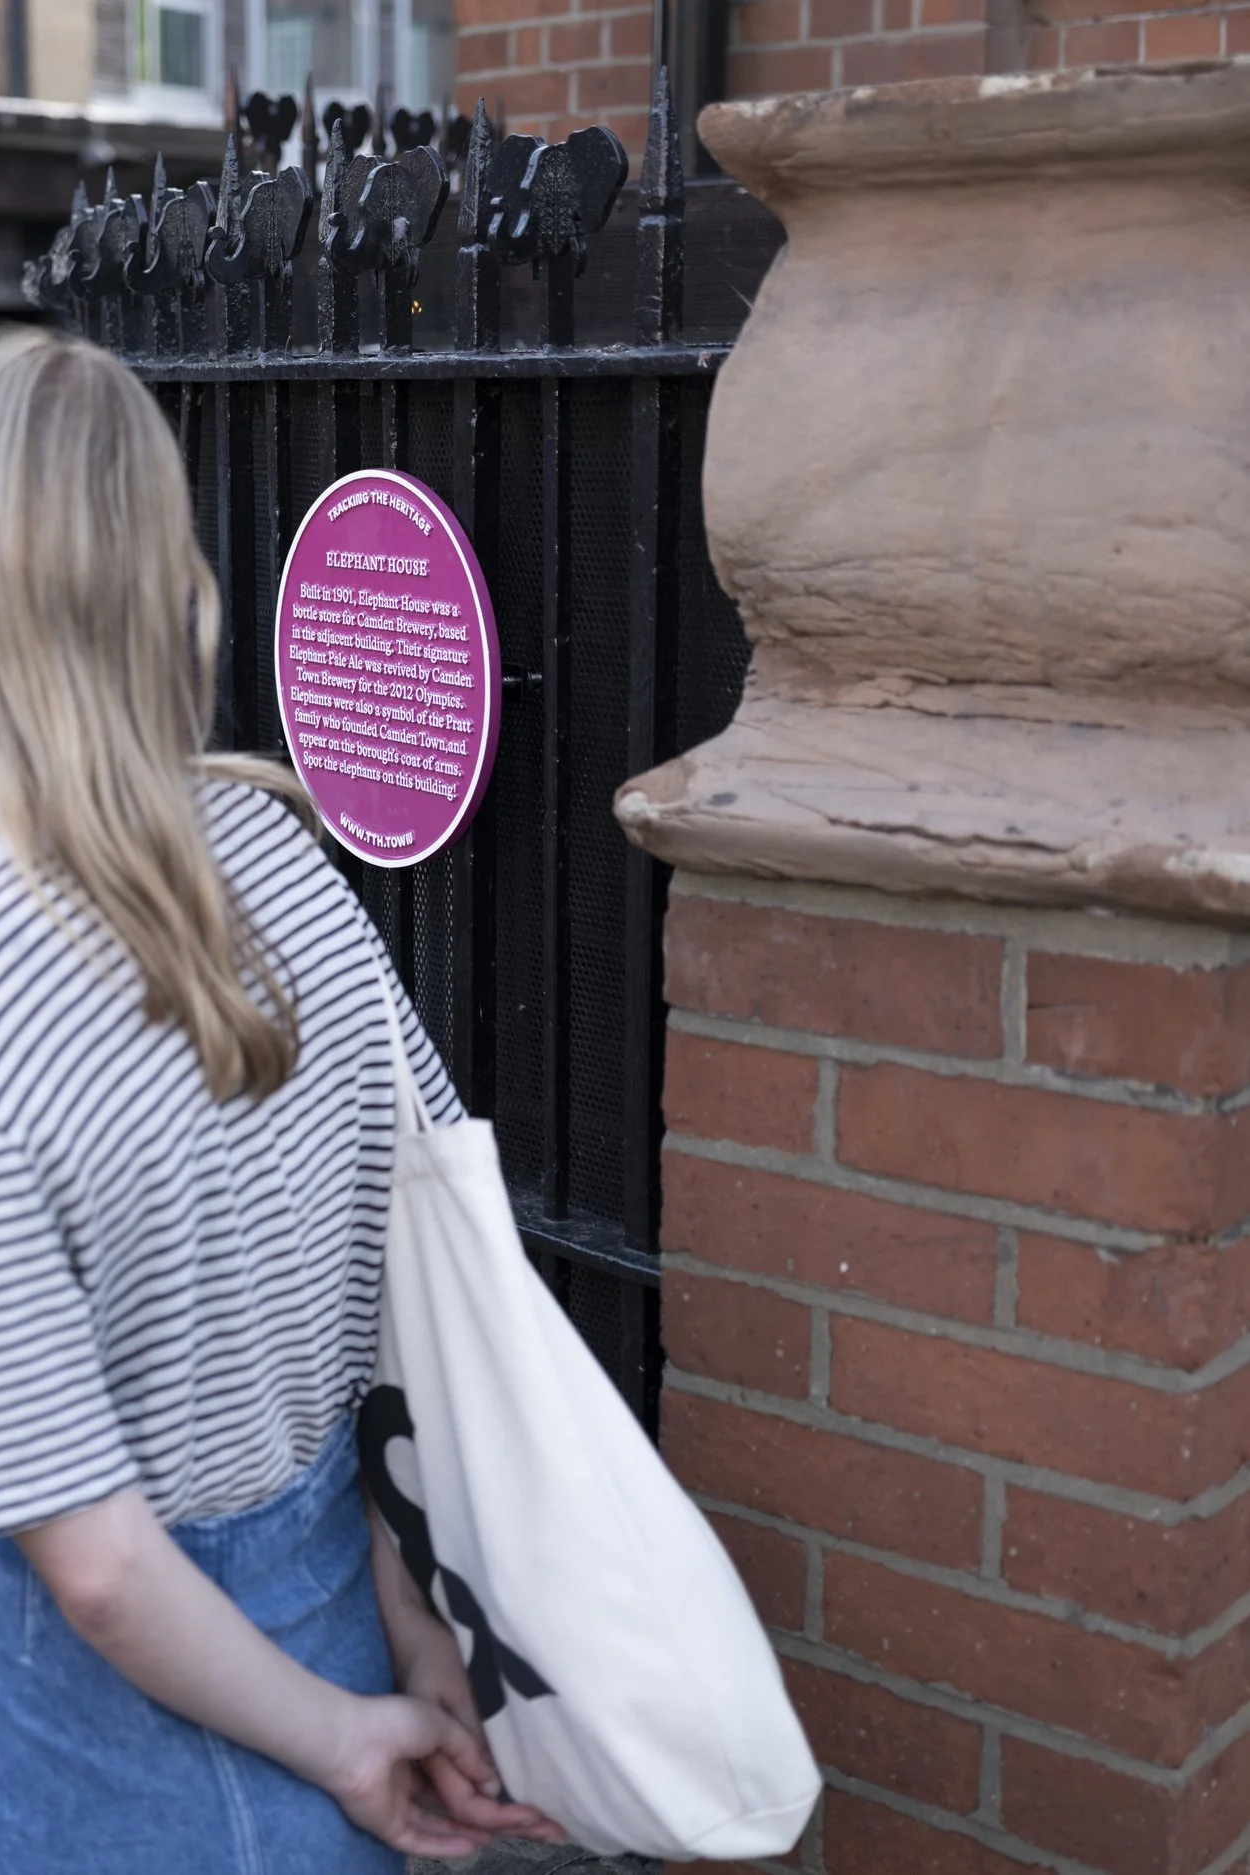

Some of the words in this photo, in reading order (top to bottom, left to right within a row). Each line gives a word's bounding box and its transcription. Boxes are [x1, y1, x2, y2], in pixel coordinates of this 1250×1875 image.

[327, 492, 370, 522] TRACKING
[370, 491, 389, 506] THE
[389, 495, 432, 537] HERITAGE
[326, 551, 385, 572] ELEPHANT
[387, 557, 428, 577] HOUSE
[300, 583, 321, 600] Built
[322, 586, 331, 602] in
[333, 587, 357, 607] 1901,
[358, 590, 399, 611] Elephant
[401, 595, 430, 613] House
[432, 602, 450, 617] was
[452, 604, 459, 618] a
[292, 603, 318, 620] bottle
[319, 609, 341, 624] store
[342, 609, 355, 626] for
[357, 612, 395, 631] Camden
[396, 617, 437, 640] Brewery,
[438, 622, 467, 642] based
[292, 624, 300, 639] in
[302, 626, 316, 641] the
[317, 629, 354, 647] adjacent
[355, 633, 394, 656] building.
[396, 639, 422, 657] Their
[423, 644, 468, 664] signature
[289, 644, 327, 664] Elephant
[328, 651, 347, 669] Pale
[348, 653, 364, 671] Ale
[365, 660, 382, 674] was
[383, 661, 417, 679] revived
[418, 664, 430, 684] by
[432, 667, 473, 688] Camden
[296, 666, 320, 684] Town
[321, 670, 357, 694] Brewery
[358, 677, 372, 693] for
[373, 679, 388, 696] the
[390, 683, 413, 700] 2012
[415, 687, 464, 710] Olympics.
[290, 686, 332, 707] Elephants
[333, 697, 354, 712] were
[355, 699, 374, 715] also
[375, 704, 381, 717] a
[382, 705, 415, 722] symbol
[416, 710, 428, 725] of
[429, 711, 444, 728] the
[445, 714, 472, 733] Pratt
[294, 707, 321, 729] family
[322, 714, 341, 730] who
[342, 717, 379, 738] founded
[379, 724, 418, 745] Camden
[298, 732, 327, 748] appear
[328, 738, 340, 751] on
[341, 739, 355, 754] the
[357, 741, 399, 765] borough's
[401, 753, 421, 768] coat
[422, 755, 434, 771] of
[435, 759, 462, 777] arms.
[303, 751, 323, 768] Spot
[324, 755, 338, 771] the
[339, 759, 381, 781] elephants
[382, 770, 395, 784] on
[396, 770, 413, 788] this
[414, 774, 457, 801] building!
[339, 812, 414, 849] WWW.TTH.TOWN
